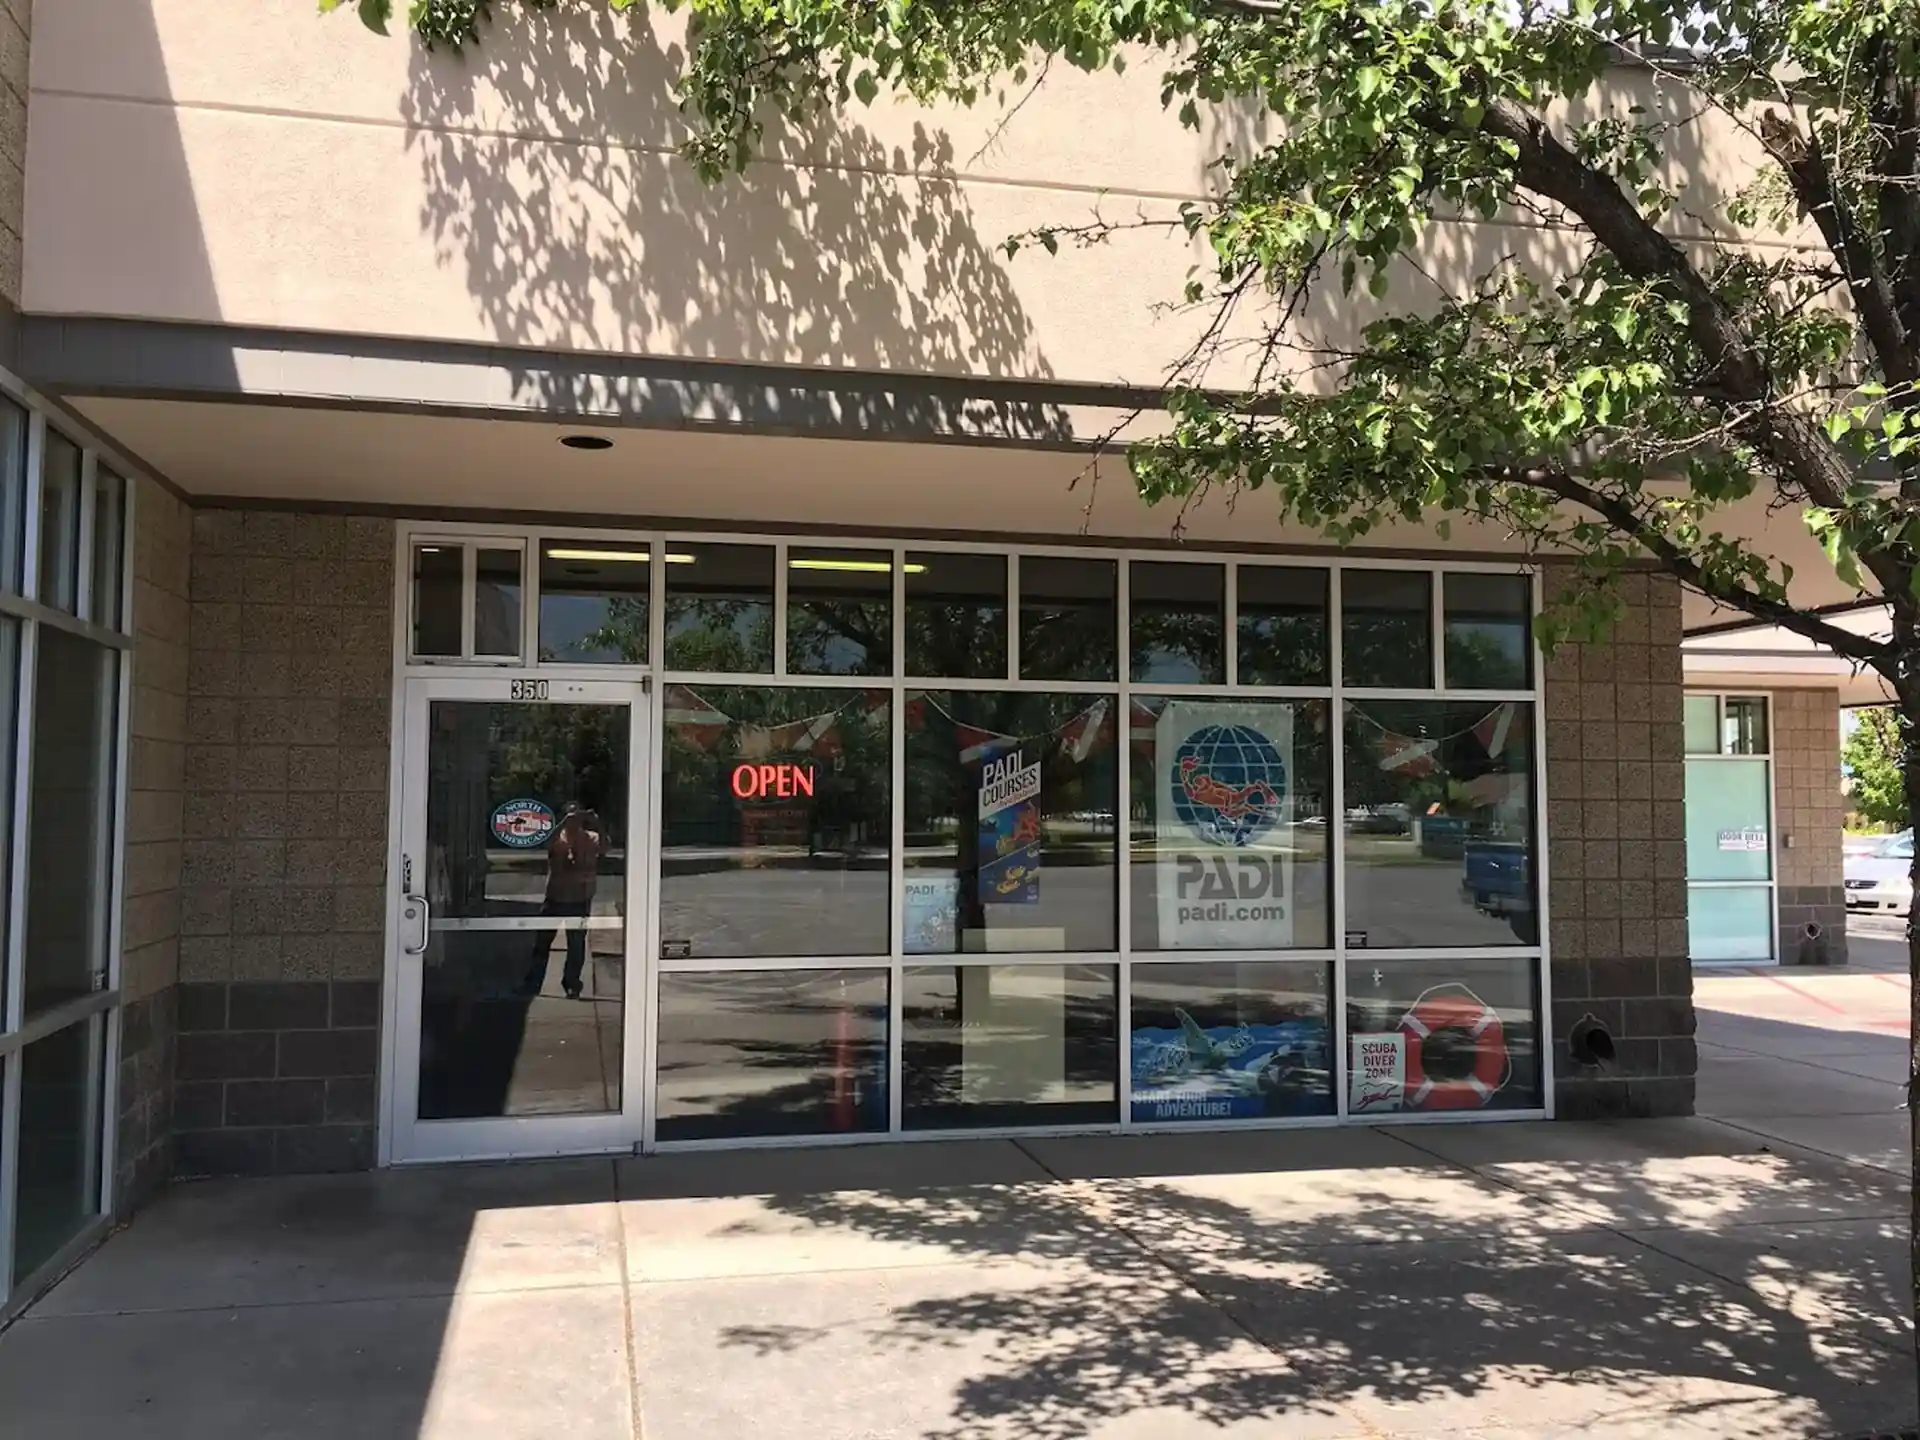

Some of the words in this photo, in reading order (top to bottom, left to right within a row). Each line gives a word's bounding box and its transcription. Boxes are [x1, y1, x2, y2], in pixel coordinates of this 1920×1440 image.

[511, 680, 549, 700] 350
[983, 749, 1022, 789] PADI
[732, 764, 814, 798] OPEN
[983, 768, 1037, 807] COURSES
[505, 802, 541, 812] NORTH
[501, 830, 546, 845] AMERICAN
[1177, 854, 1284, 900] PADI
[905, 885, 935, 895] PADI
[1178, 902, 1285, 925] padi.com
[1362, 1042, 1397, 1054] SCUBA
[1364, 1055, 1396, 1067] DIVER
[1365, 1067, 1394, 1079] ZONE
[1156, 1102, 1231, 1117] ADVENTURE!
